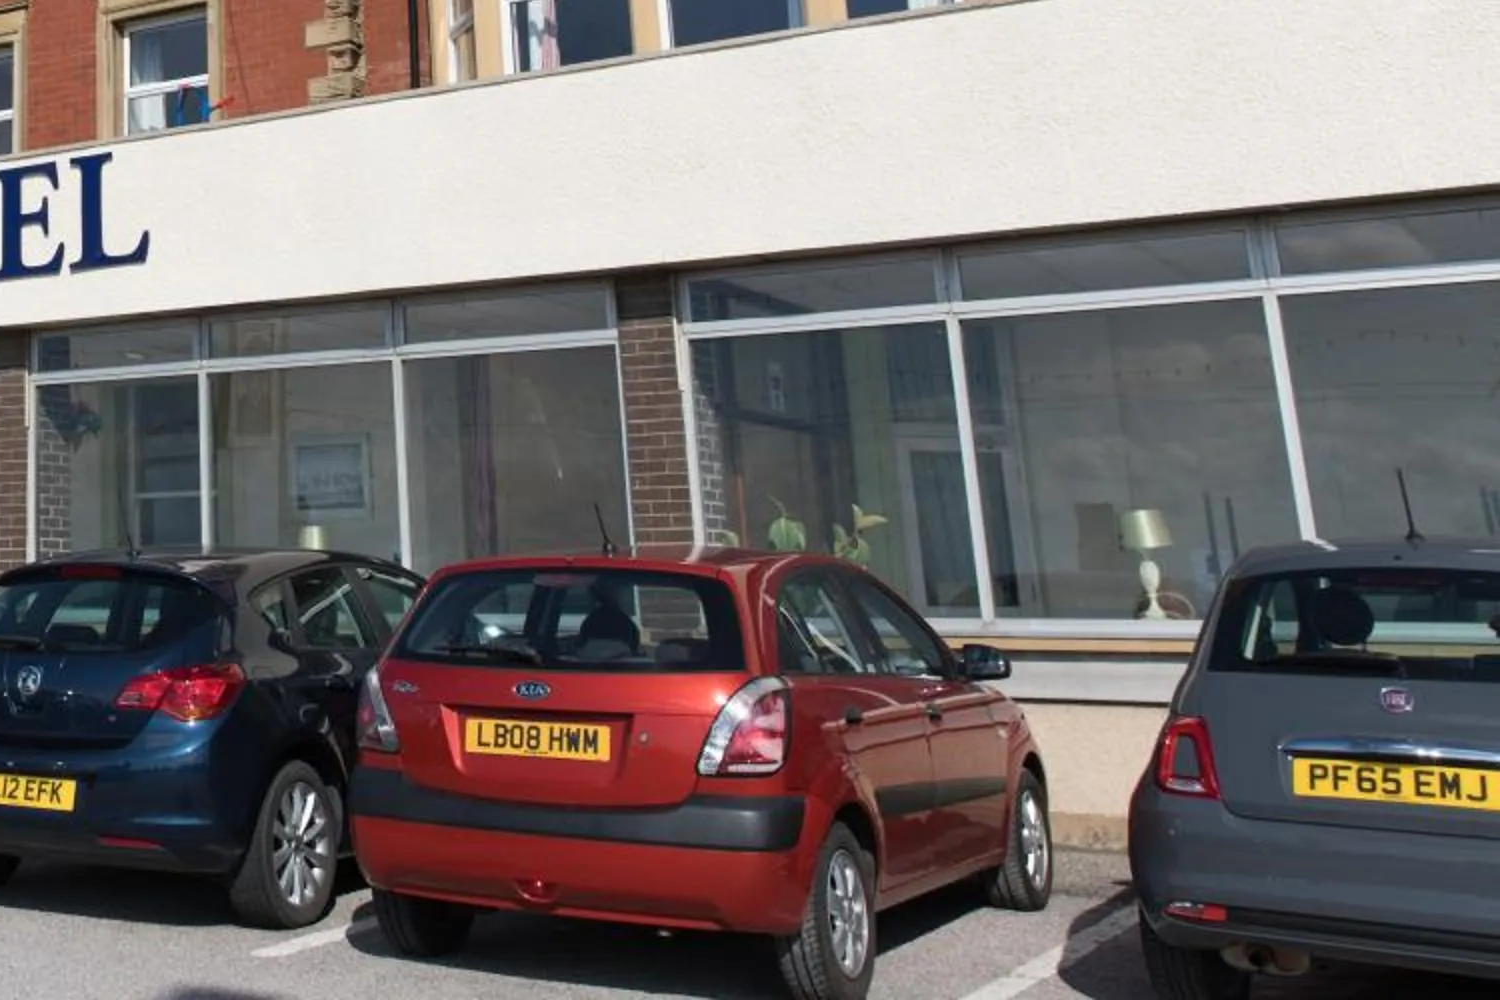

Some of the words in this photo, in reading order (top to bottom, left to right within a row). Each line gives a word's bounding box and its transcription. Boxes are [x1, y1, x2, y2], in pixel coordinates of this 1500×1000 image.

[519, 683, 547, 696] KIA
[477, 721, 541, 750] LB08
[548, 726, 599, 755] HWM
[23, 779, 63, 804] EFK
[1309, 763, 1402, 795] PF65
[1414, 769, 1489, 802] EMJ
